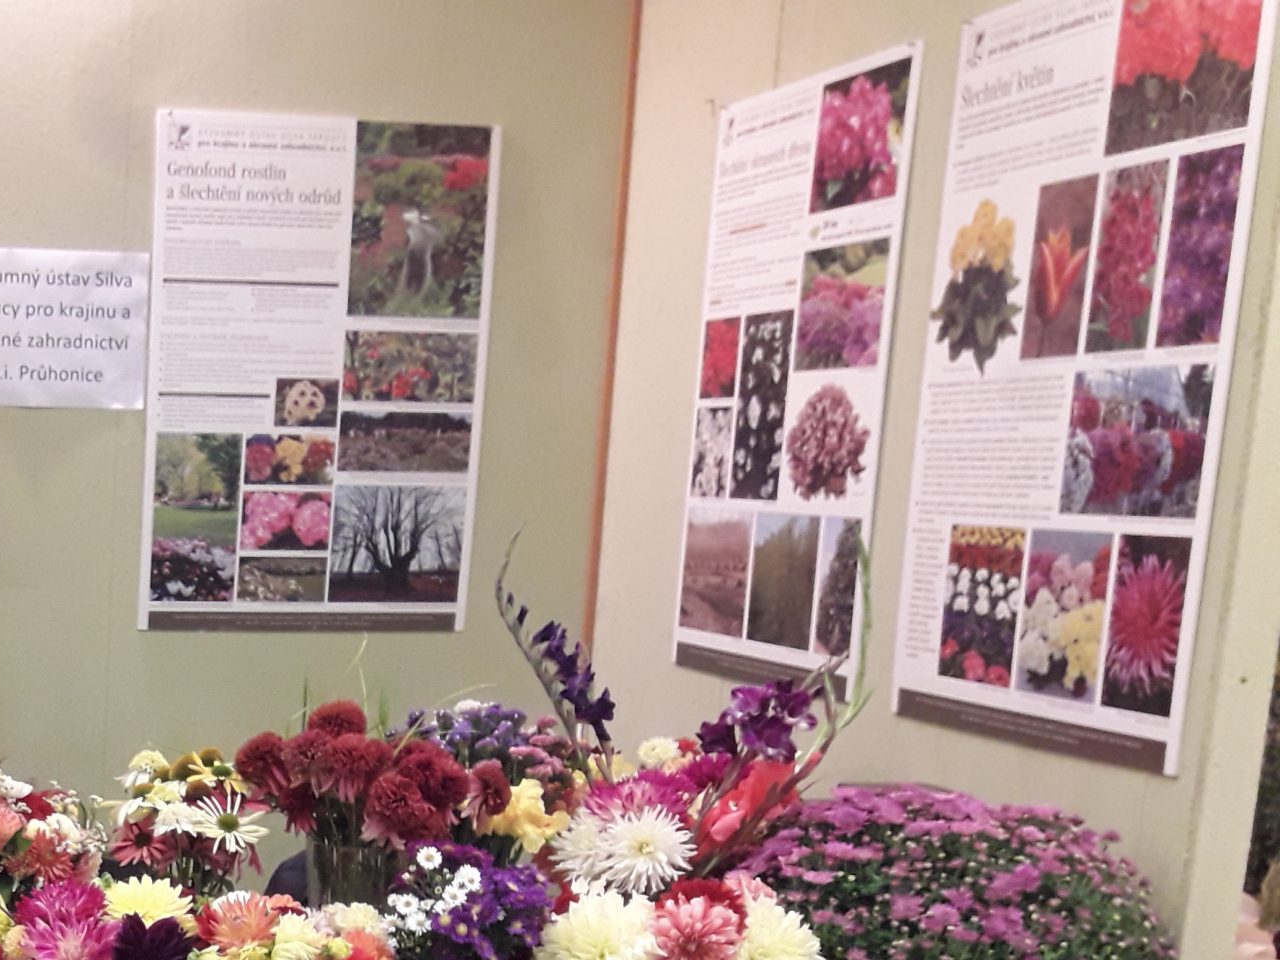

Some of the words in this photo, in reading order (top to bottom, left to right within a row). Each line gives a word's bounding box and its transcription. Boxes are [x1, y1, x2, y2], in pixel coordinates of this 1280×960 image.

[167, 160, 236, 178] Genofond
[241, 163, 287, 180] rostlin
[166, 187, 175, 199] a
[246, 186, 294, 207] nových
[299, 187, 342, 206] odrůd
[47, 270, 90, 286] ústav
[96, 271, 133, 288] Silva
[26, 305, 54, 320] pro
[60, 302, 116, 322] krajinu
[122, 307, 131, 319] a
[28, 332, 130, 350] zahradnictví
[19, 364, 104, 383] Průhonice
